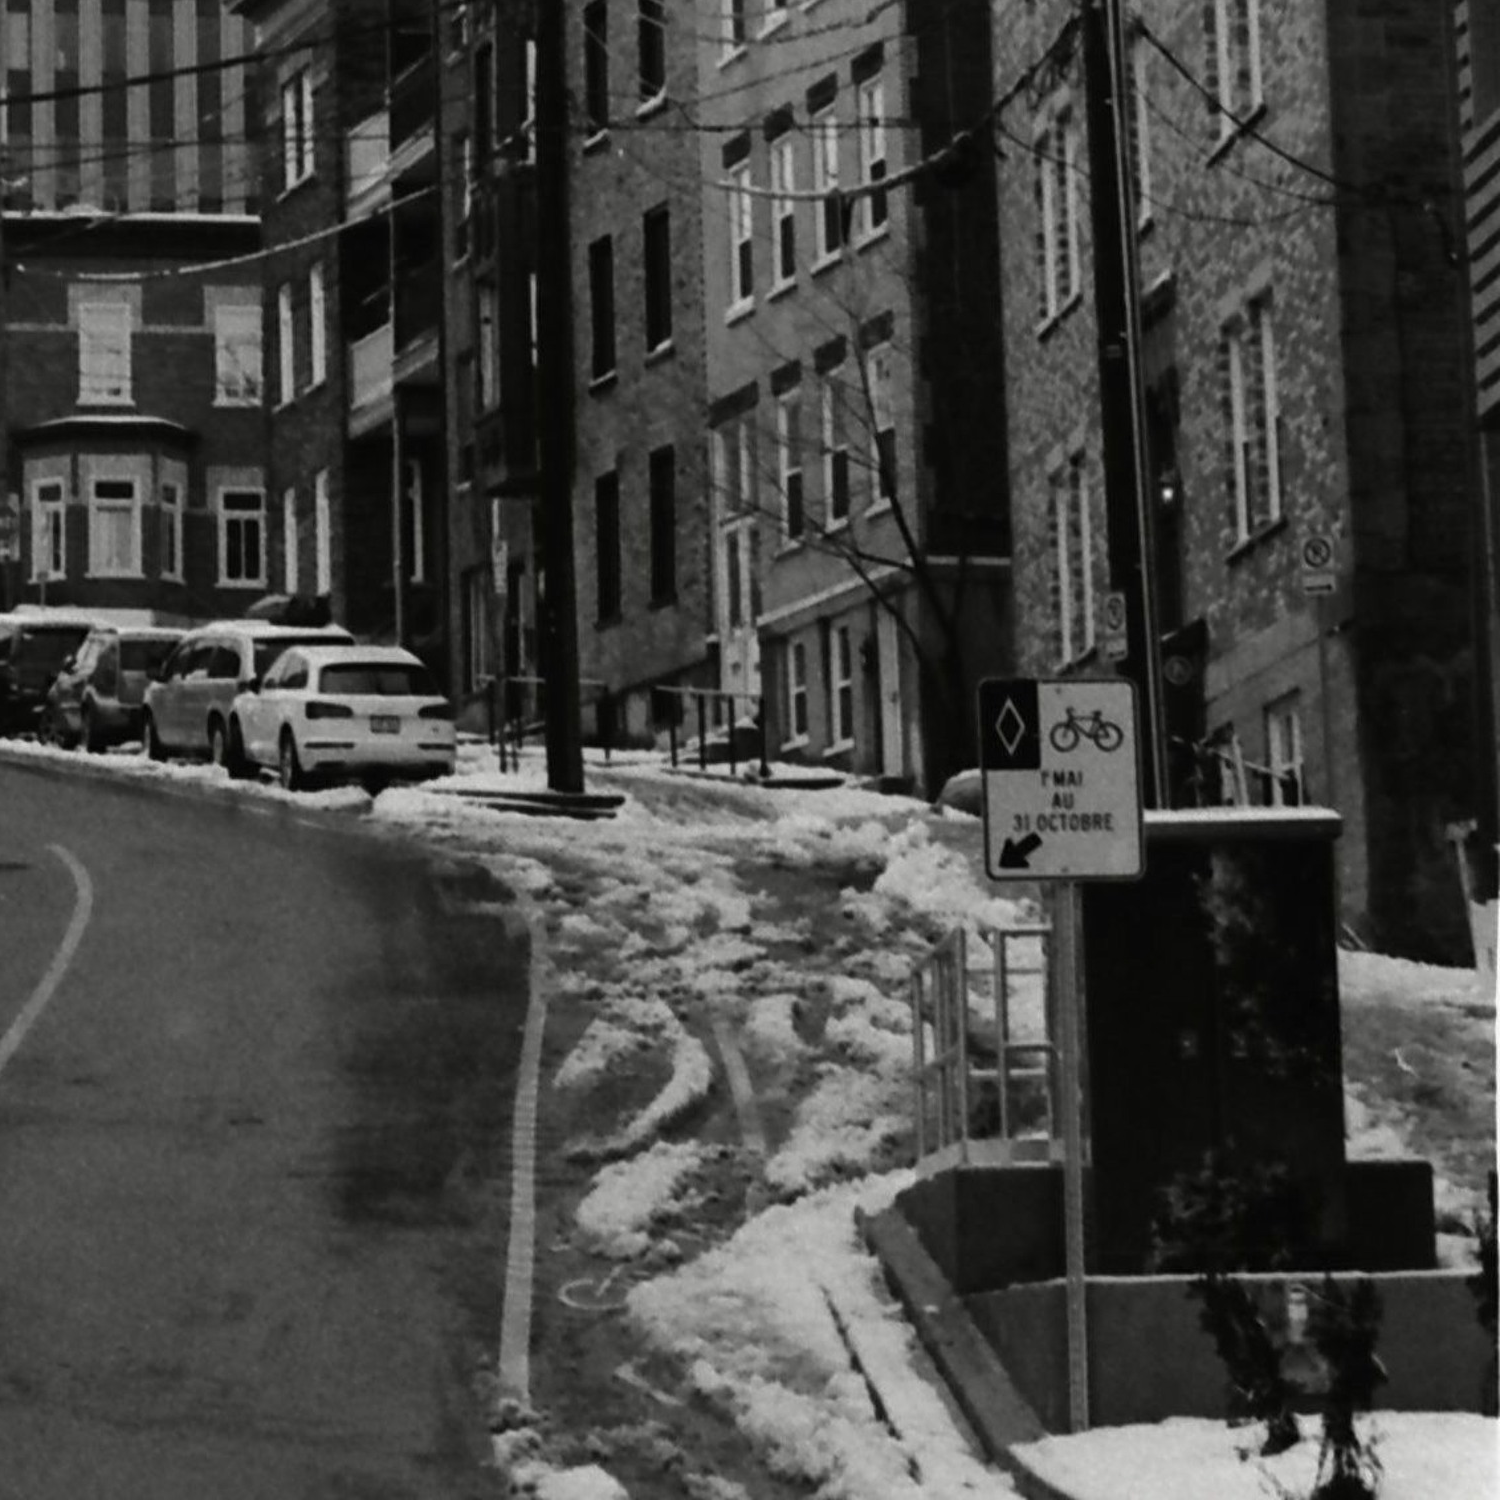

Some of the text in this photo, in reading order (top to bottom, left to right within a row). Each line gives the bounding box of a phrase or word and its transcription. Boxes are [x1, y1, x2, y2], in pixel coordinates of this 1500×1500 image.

[1053, 769, 1084, 787] MAI
[1051, 792, 1075, 810] AU
[1013, 813, 1114, 832] 31 OCTOBRE
